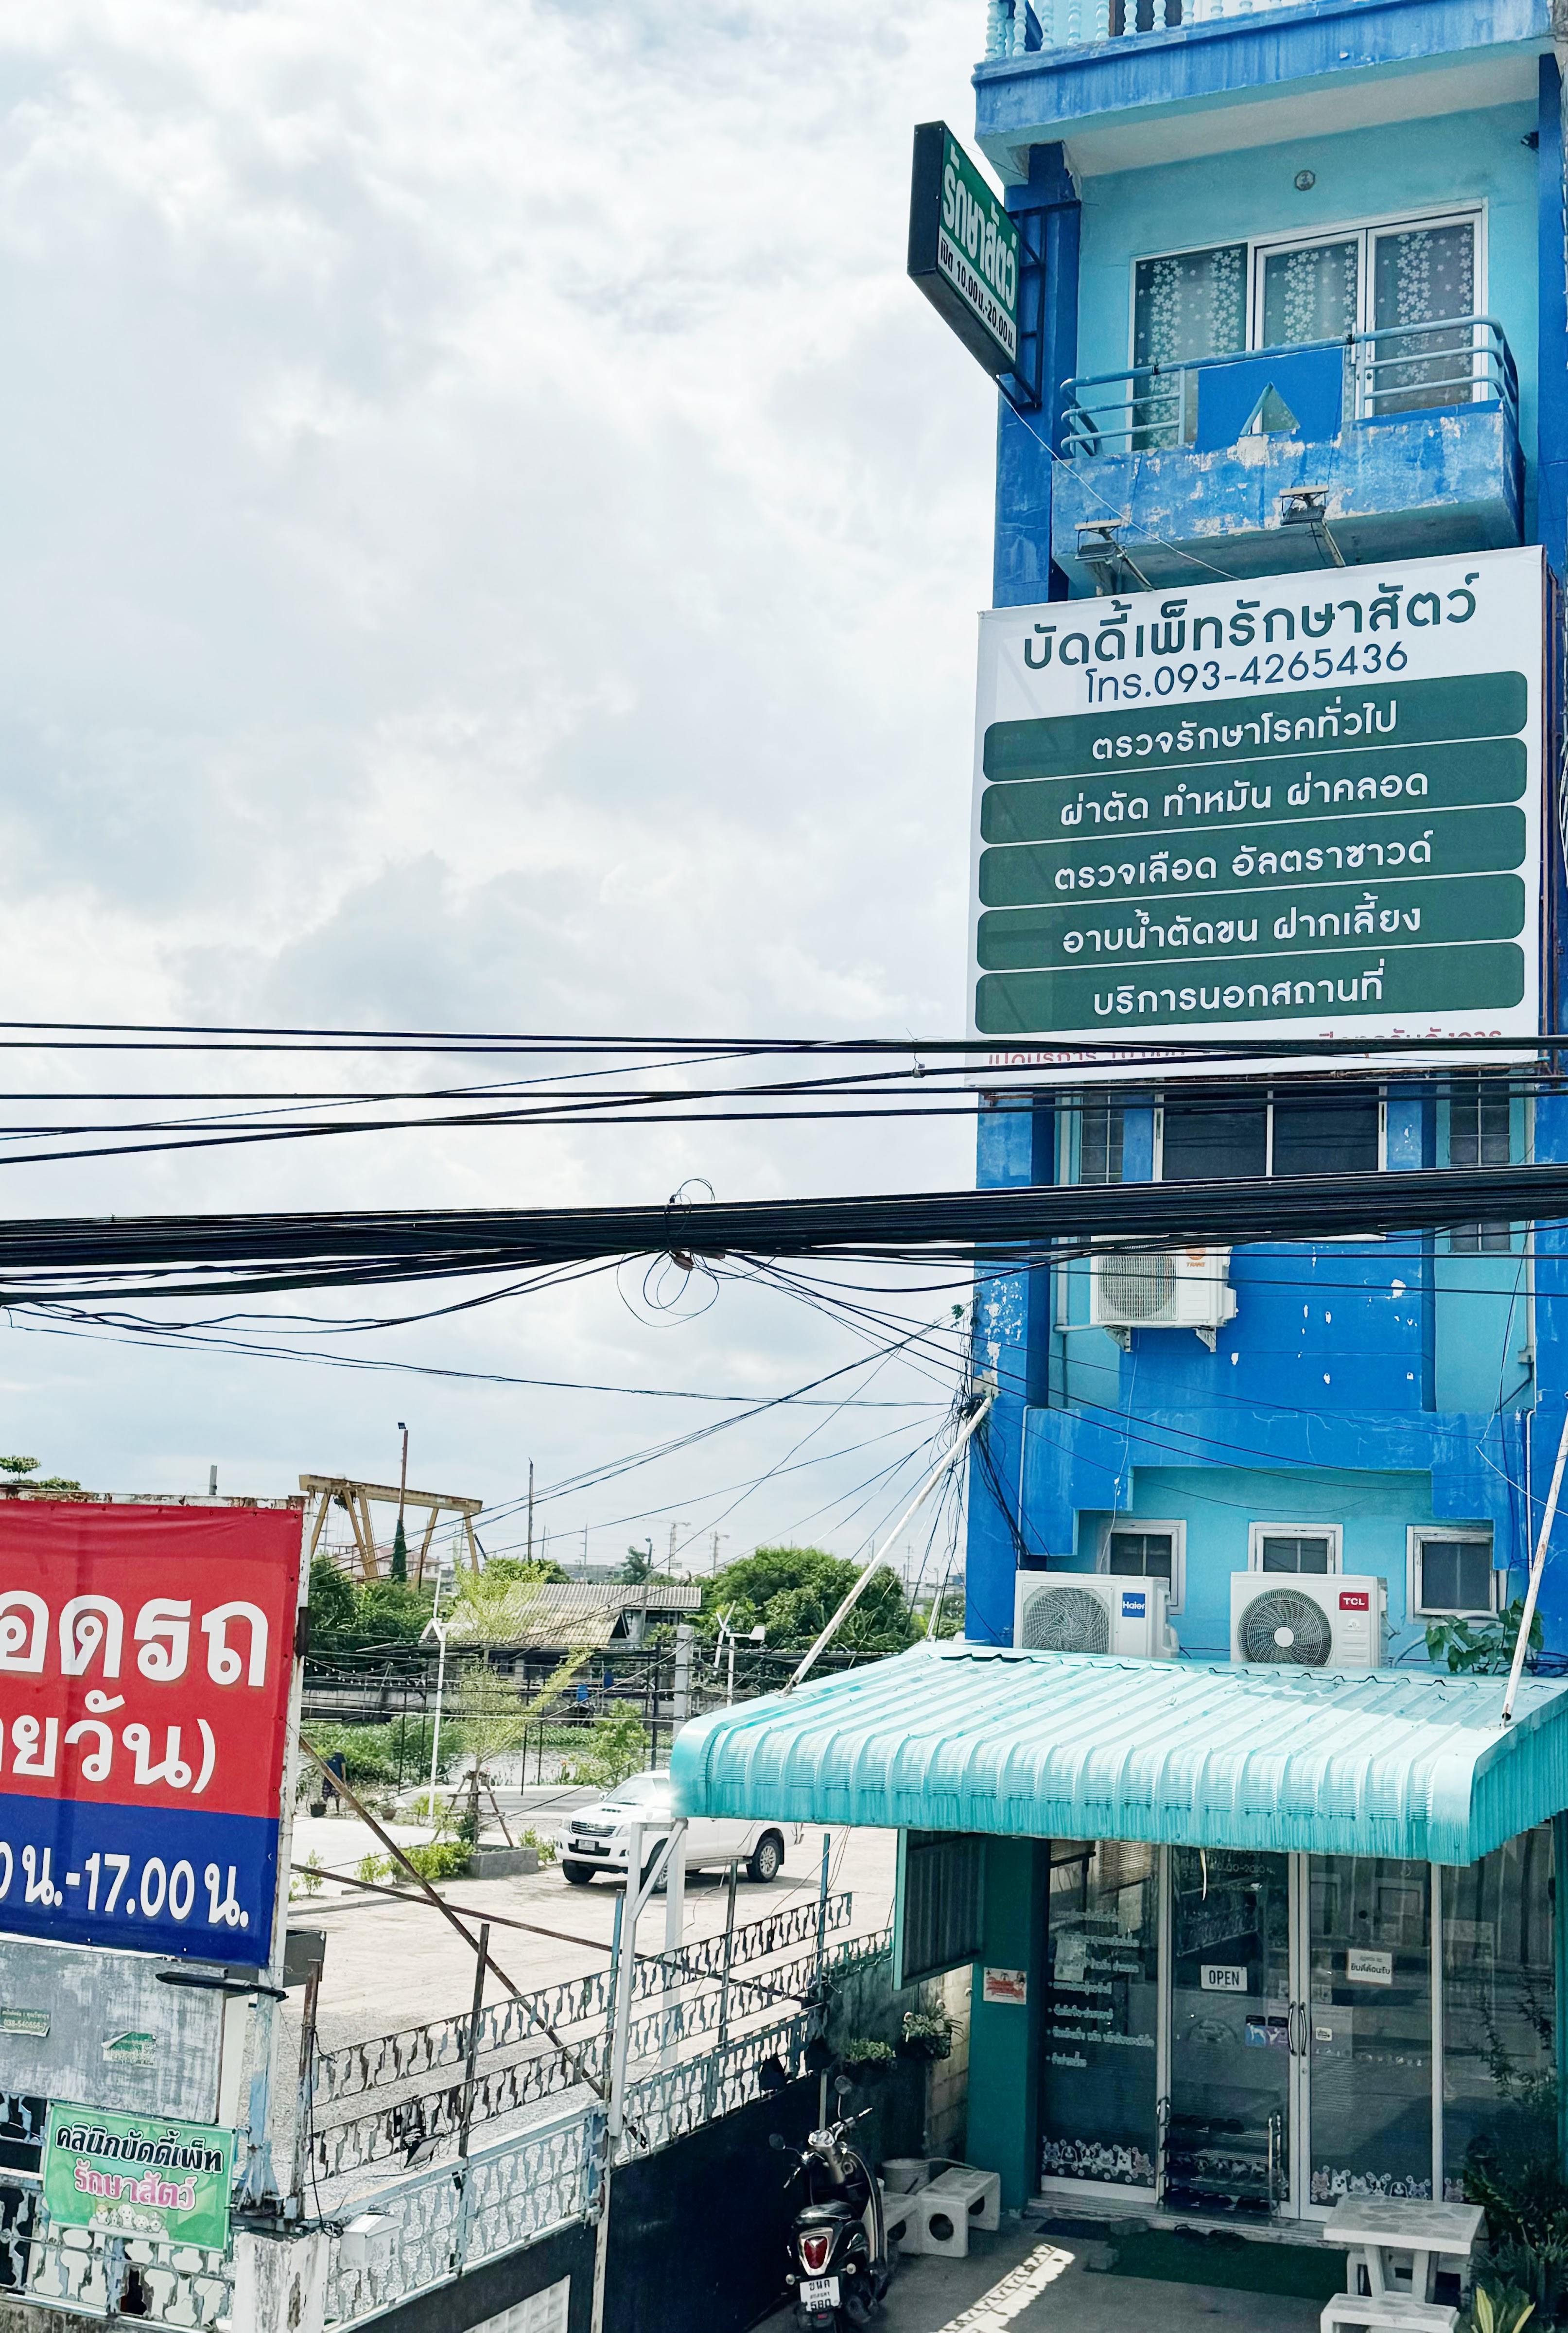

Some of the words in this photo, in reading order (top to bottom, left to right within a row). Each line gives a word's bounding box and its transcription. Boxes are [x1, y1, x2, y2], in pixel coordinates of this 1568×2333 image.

[941, 237, 953, 272] เปิด
[943, 143, 1017, 311] รักษาสัตว์
[1024, 572, 1480, 669] บัดดี้เพ็ทรักษาสัตว์
[1085, 641, 1408, 703] โทร.093-4265436
[1092, 696, 1396, 760] ตรวจรักษาโรคทั่วไป
[1061, 791, 1148, 825] ผ่าตัด
[1164, 780, 1271, 817] ทำหมัน
[1287, 772, 1428, 806] ผ่าคลอด
[1055, 851, 1216, 890] ตรวจเลือด
[1232, 830, 1433, 877] อัลตราซาวด์
[1063, 908, 1257, 953] อาบน้ำตัดขน
[1273, 893, 1420, 939] ฝากเลี้ยง
[1094, 958, 1385, 1015] บริการนอกสถานที่
[1123, 1601, 1145, 1609] Haier
[1343, 1597, 1365, 1606] TCL
[0, 1689, 215, 1793] ยวัน)
[1209, 1970, 1239, 1985] OPEN
[56, 2123, 224, 2174] คลินิกบัดดี้เพ็ท
[75, 2159, 197, 2210] รักษาสัตว์
